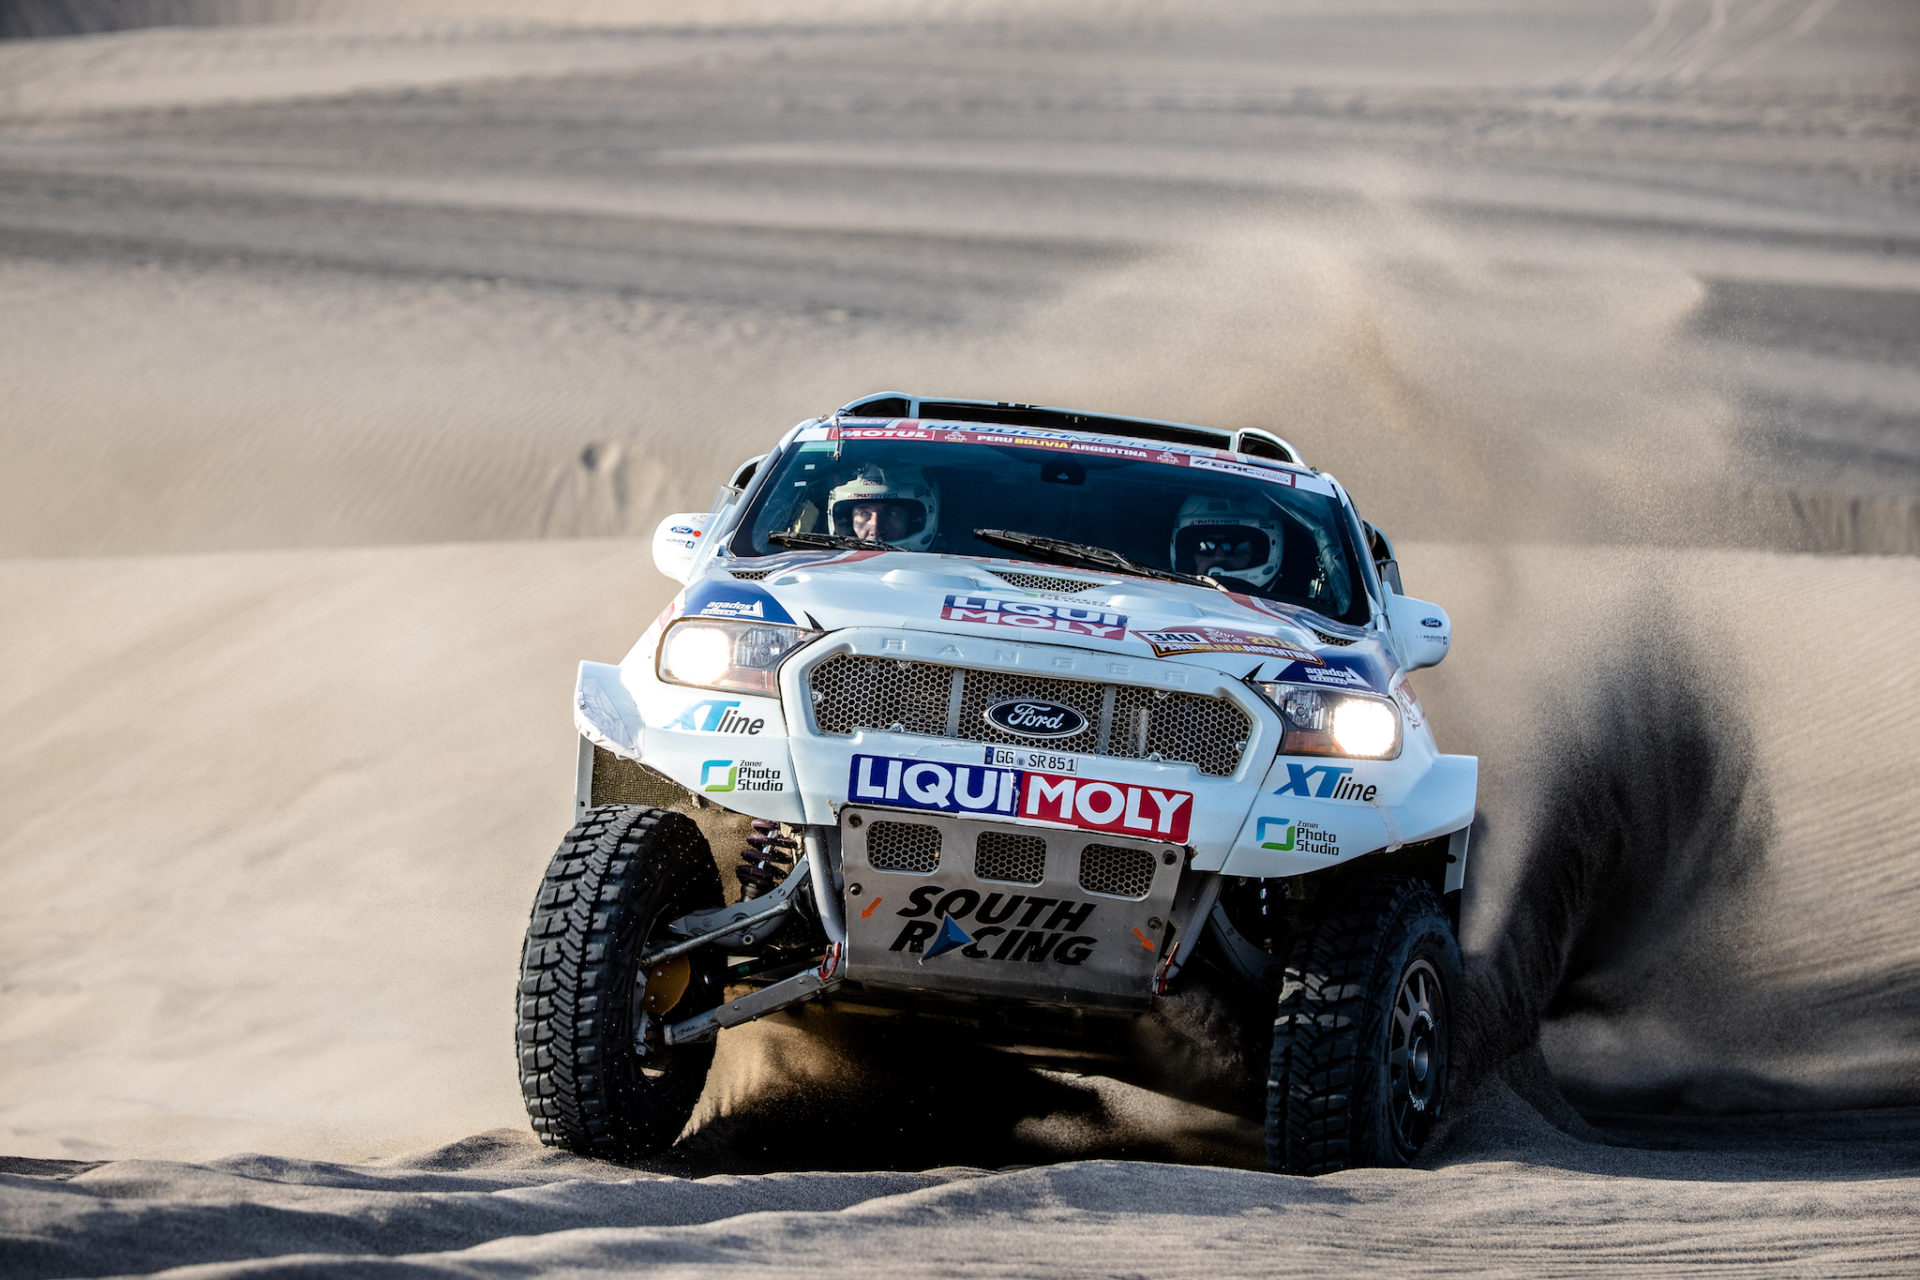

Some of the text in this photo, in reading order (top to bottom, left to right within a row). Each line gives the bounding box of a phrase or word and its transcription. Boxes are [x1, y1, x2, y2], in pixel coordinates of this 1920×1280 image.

[840, 429, 929, 438] MOTUL
[977, 434, 1147, 458] PERU BOLIVIA ARGENTINA
[707, 601, 752, 610] agados
[953, 596, 1119, 626] LIQUI
[950, 608, 1122, 638] MOLY
[1151, 633, 1199, 642] 340
[1305, 667, 1353, 678] agados
[663, 701, 765, 735] XTline
[1008, 702, 1062, 730] Ford
[995, 750, 1014, 764] GG
[738, 768, 780, 780] Photo
[737, 779, 783, 792] Studio
[1273, 763, 1377, 802] XTline
[856, 757, 1190, 835] LIQUI MOLY
[1297, 820, 1319, 829] Zoner
[1297, 827, 1337, 843] Photo
[1296, 840, 1340, 856] Studio
[896, 885, 1097, 932] SOUTH
